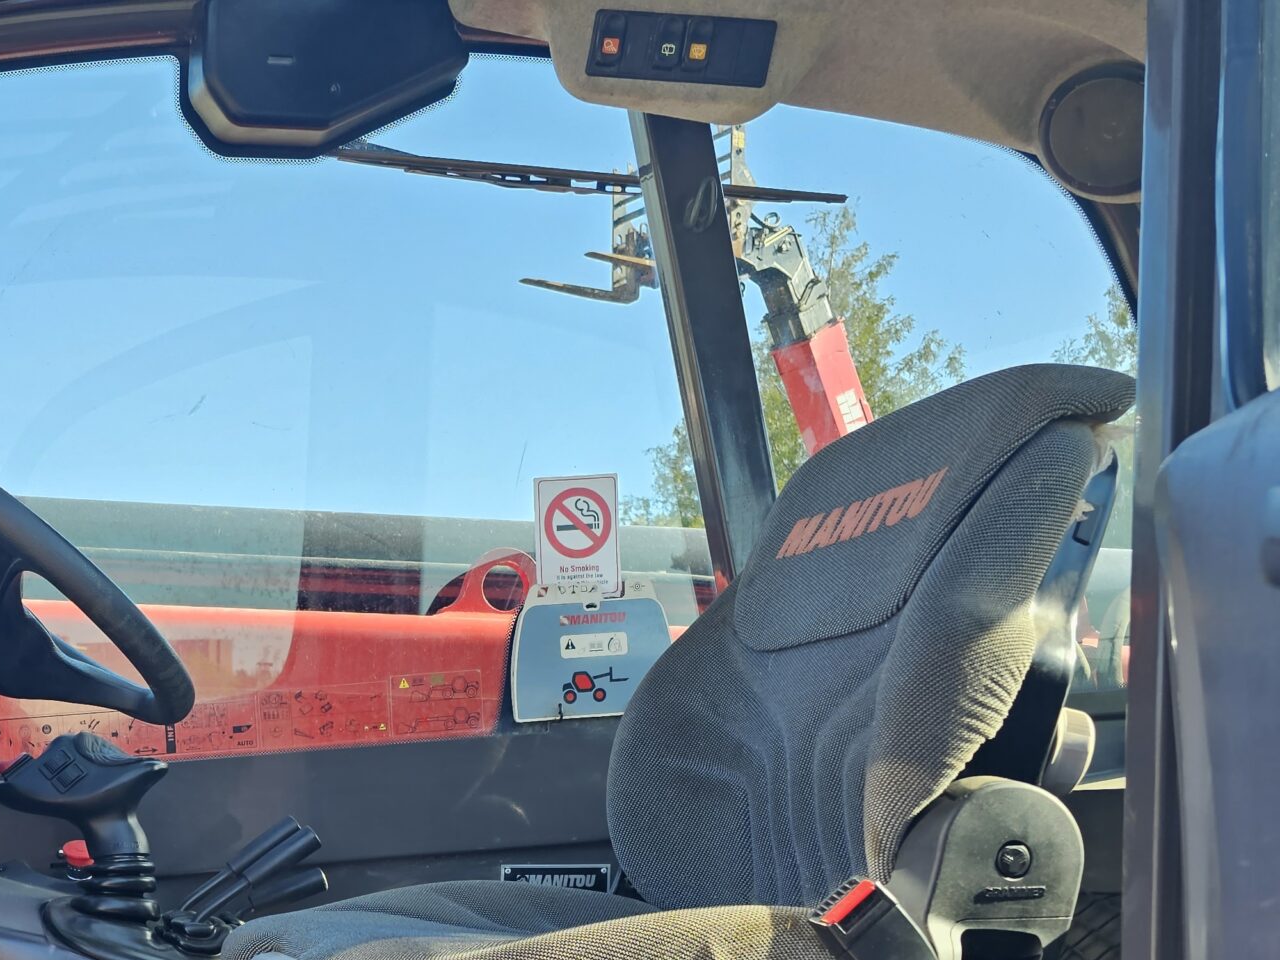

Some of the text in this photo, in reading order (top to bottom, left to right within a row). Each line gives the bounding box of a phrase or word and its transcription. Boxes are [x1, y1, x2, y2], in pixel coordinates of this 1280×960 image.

[776, 466, 949, 560] MANITOU
[559, 564, 600, 573] No Smoking
[570, 612, 625, 625] MANITOU
